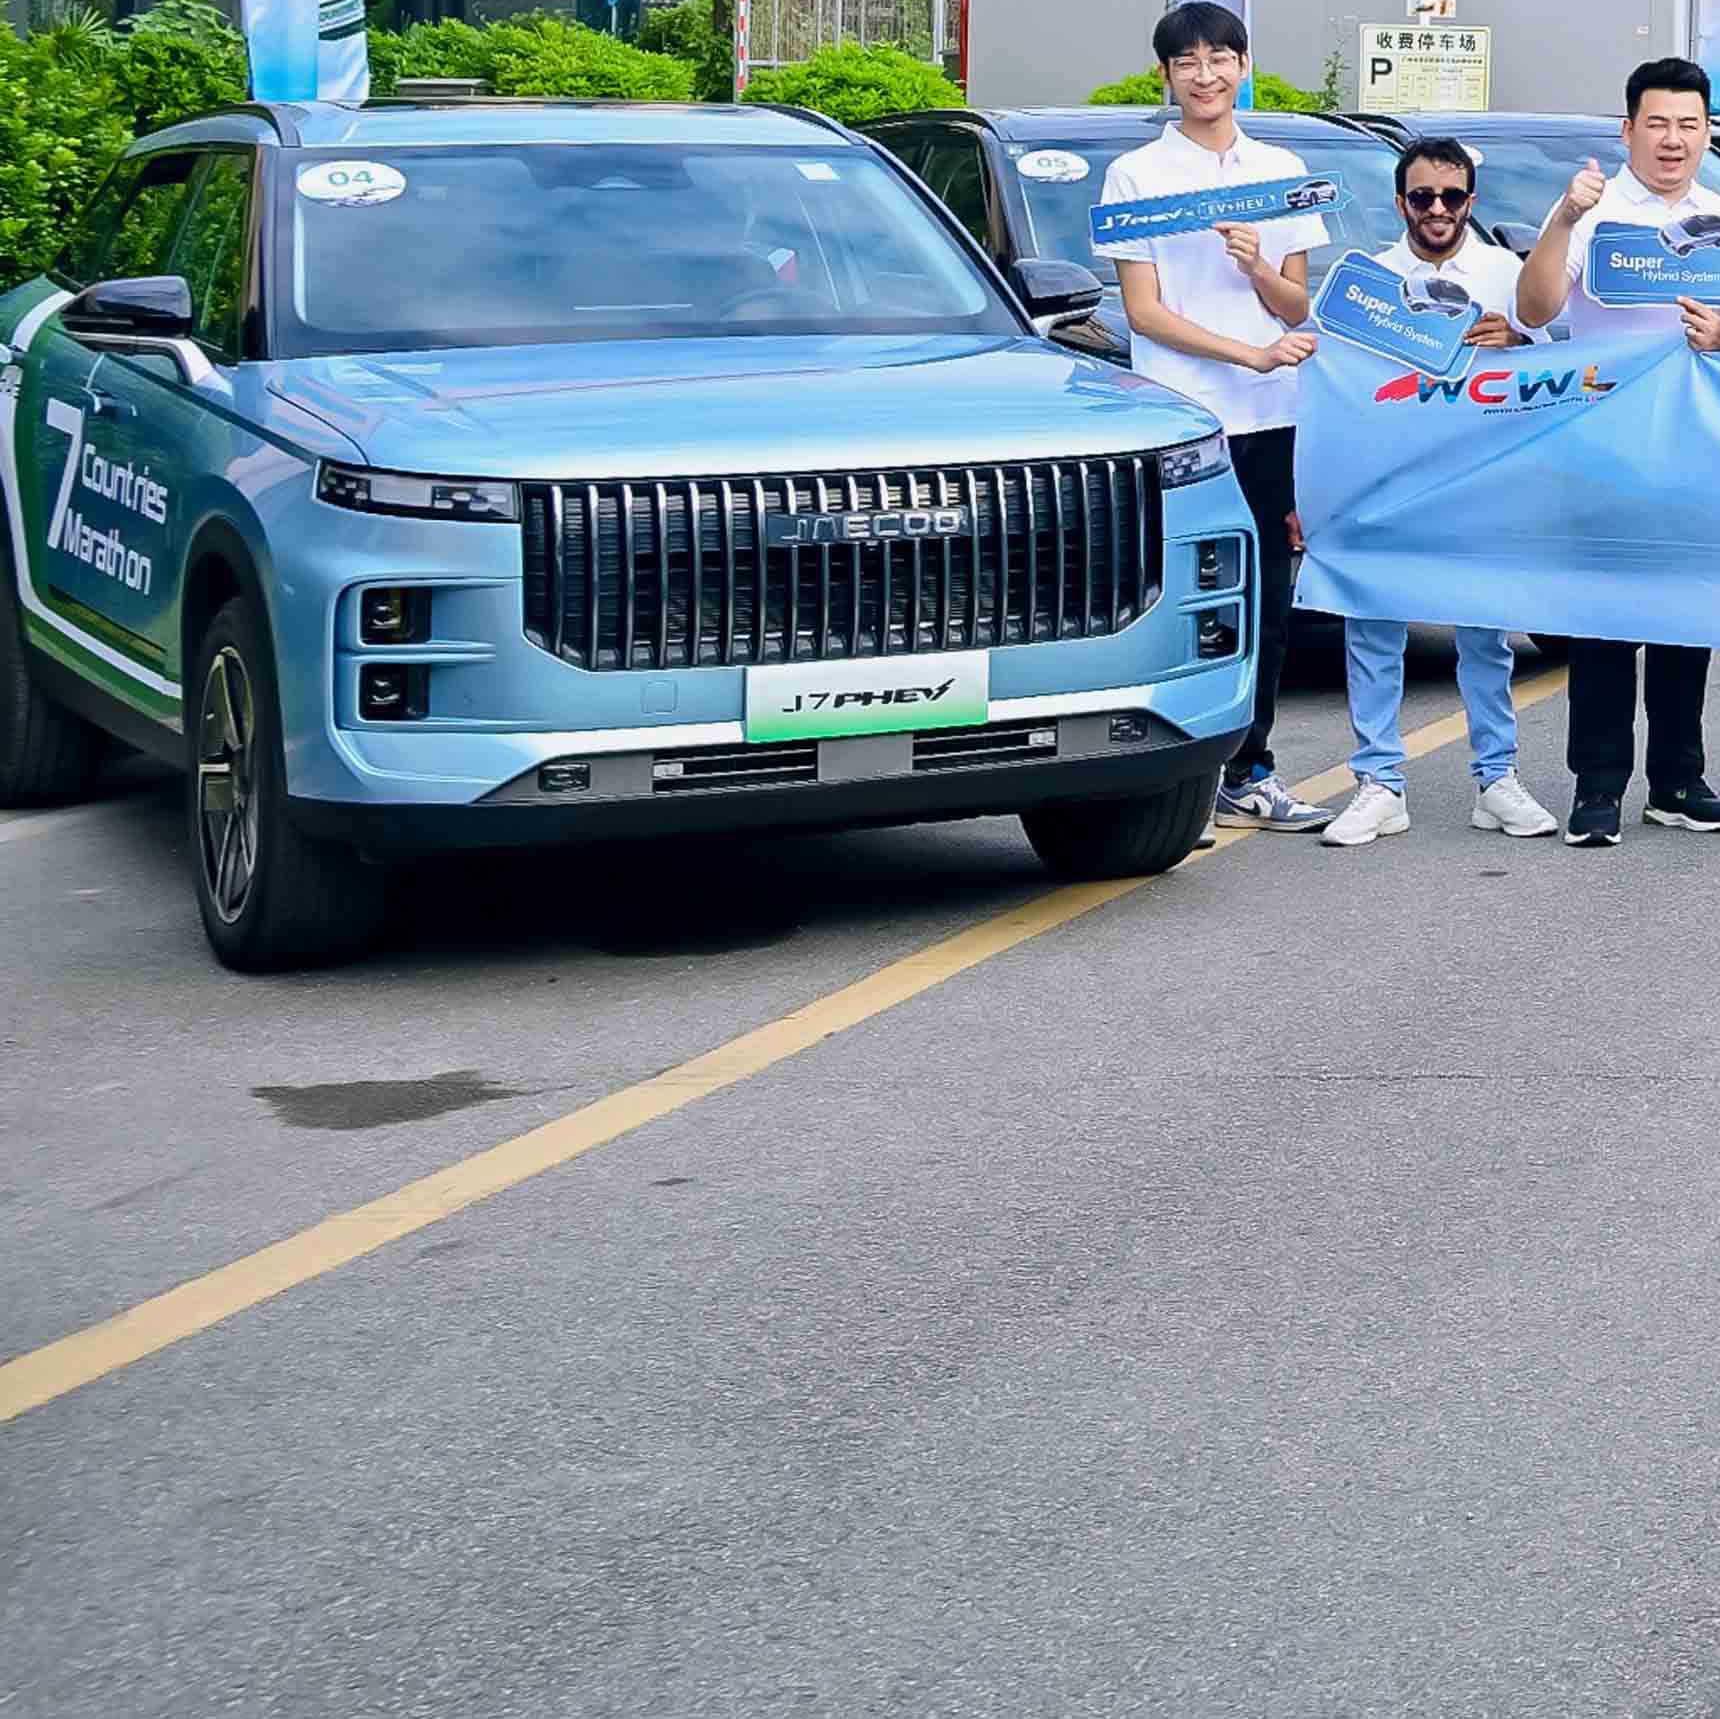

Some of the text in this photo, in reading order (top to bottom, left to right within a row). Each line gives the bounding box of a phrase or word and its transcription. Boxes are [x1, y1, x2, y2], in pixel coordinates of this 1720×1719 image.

[1376, 31, 1476, 52] 收费停车场
[1370, 57, 1393, 85] P
[328, 170, 374, 186] 04
[1207, 197, 1266, 217] EV+HEV
[1609, 251, 1665, 272] Super
[1642, 269, 1680, 285] Hybrid
[1345, 283, 1398, 316] Super
[1367, 310, 1444, 350] Hybrid System
[46, 397, 168, 550] 7 Countries
[780, 512, 961, 541] JAECOO
[62, 506, 152, 596] Marathon
